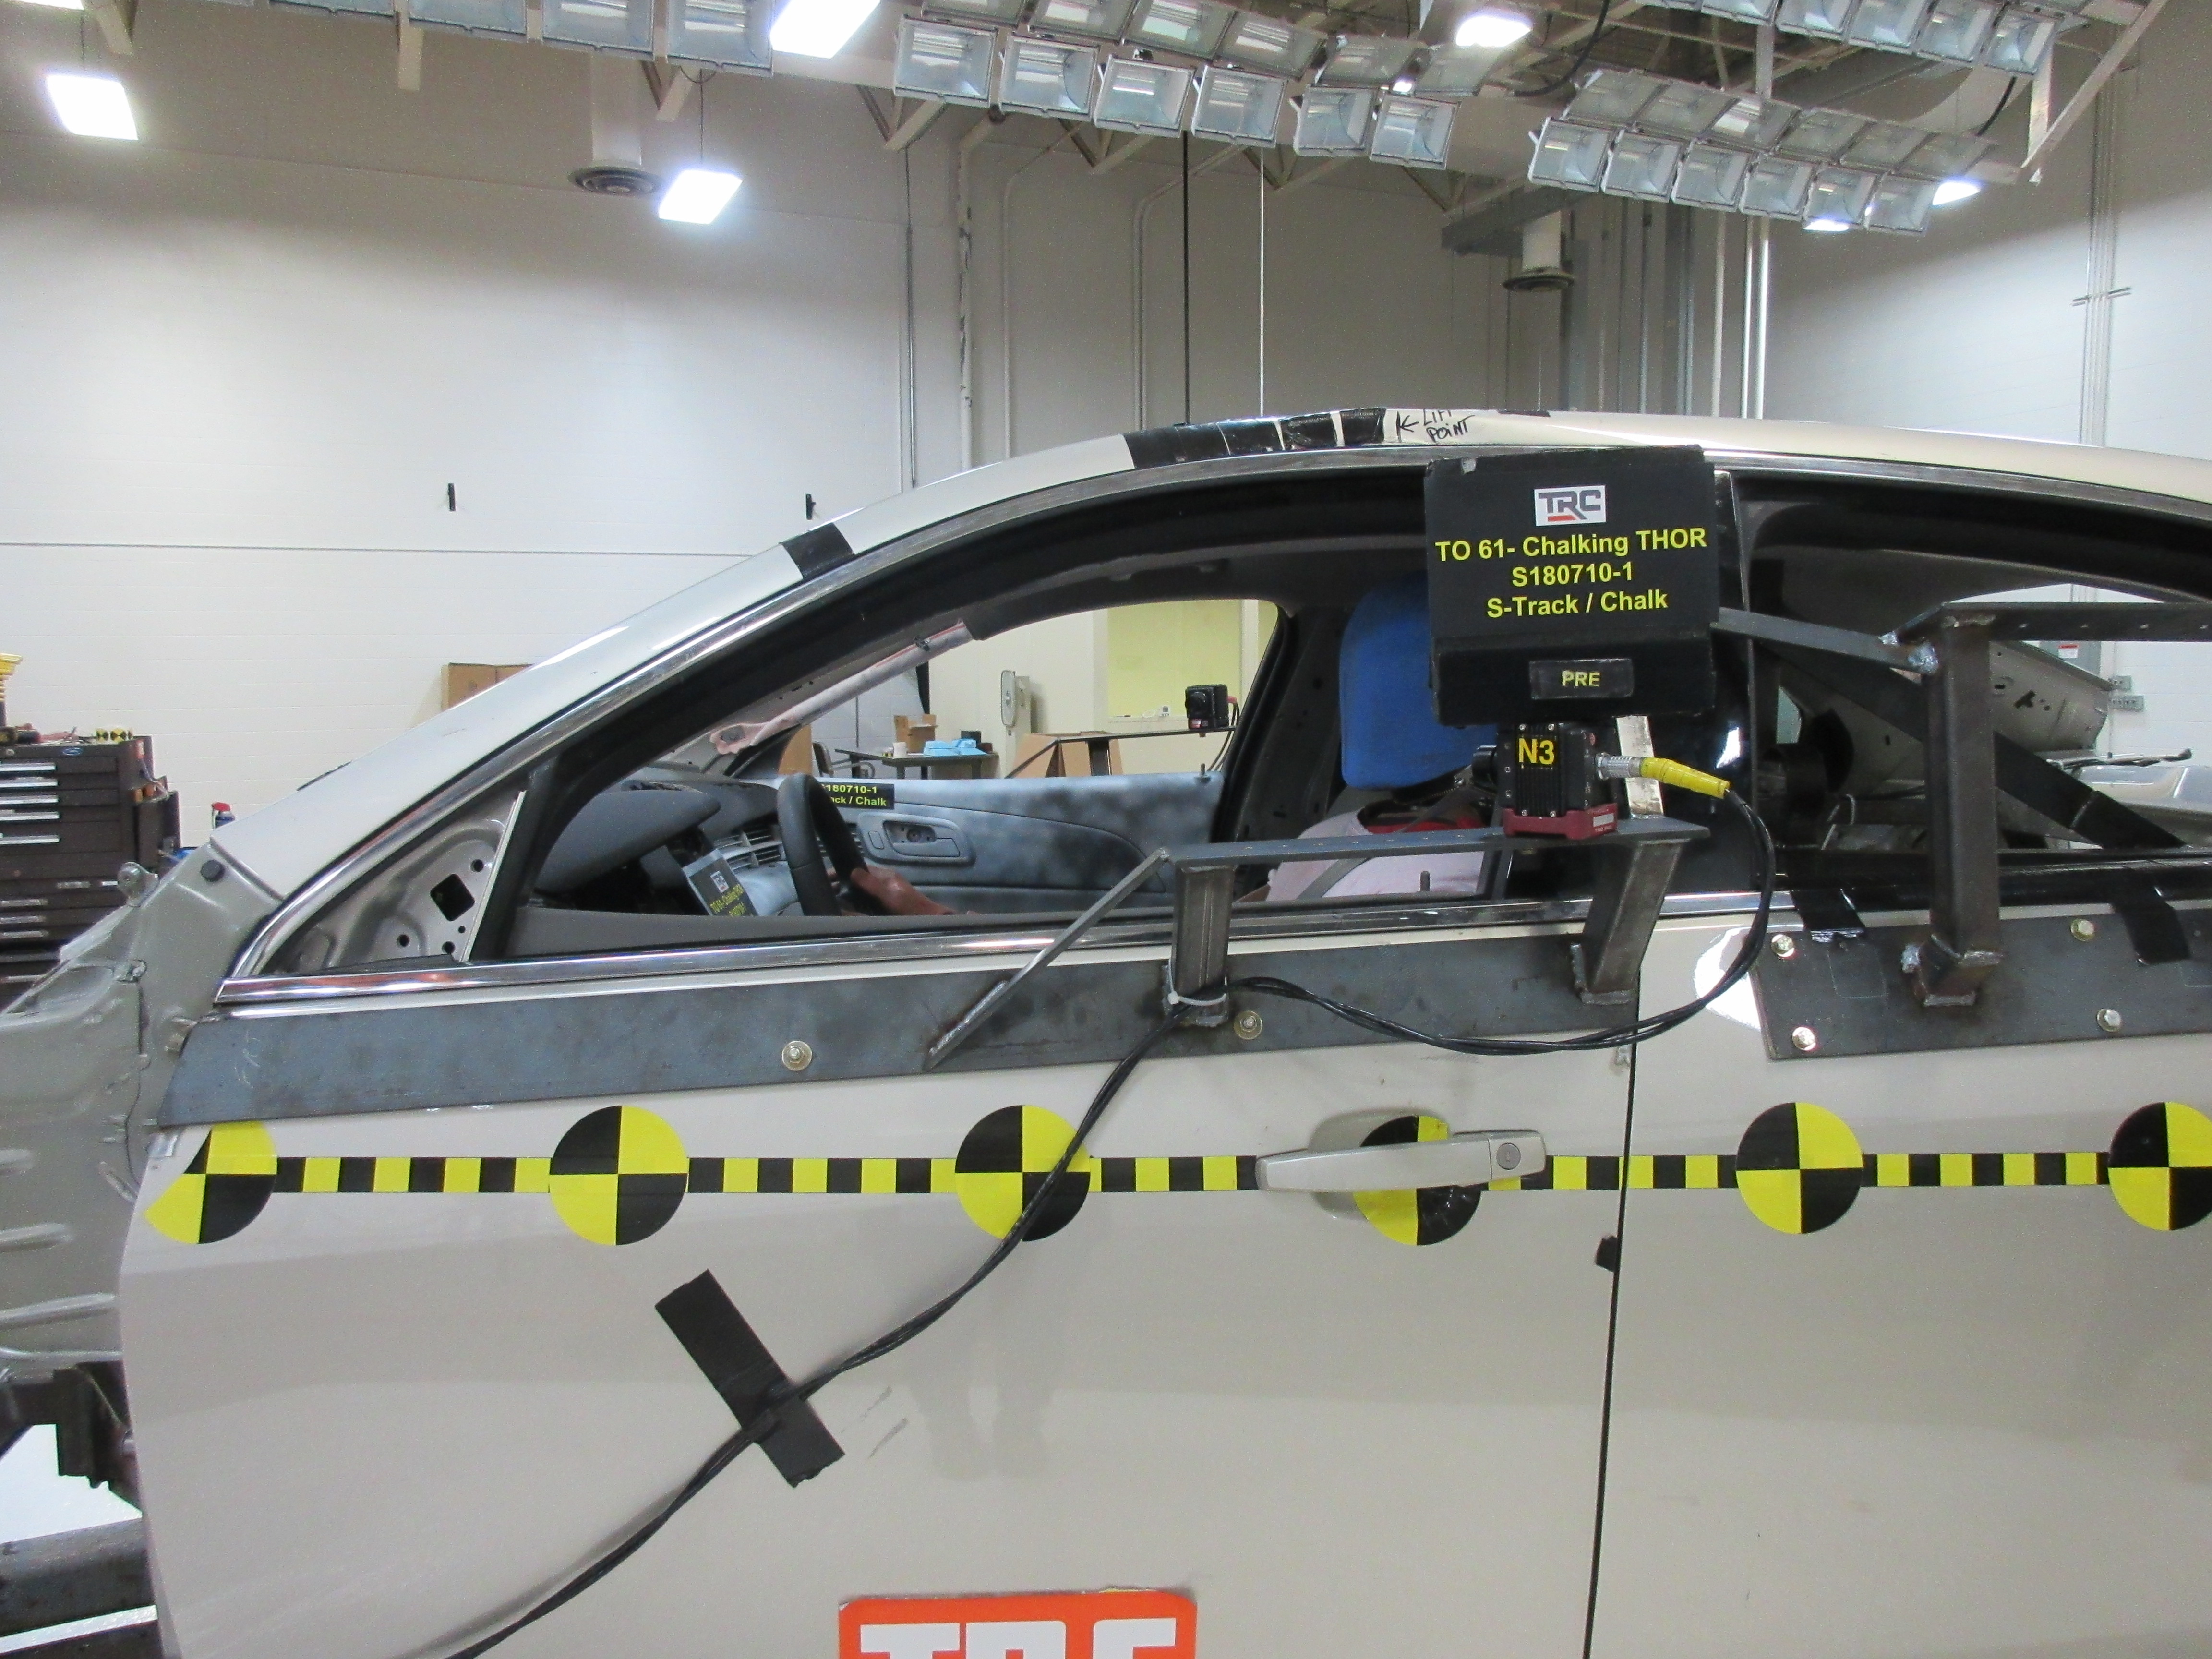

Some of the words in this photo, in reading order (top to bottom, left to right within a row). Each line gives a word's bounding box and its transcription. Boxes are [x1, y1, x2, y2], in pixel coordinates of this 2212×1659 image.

[1538, 490, 1601, 520] TRC
[1435, 540, 1471, 562] TO
[1479, 538, 1515, 559] 61-
[1523, 534, 1629, 557] Chalking
[1636, 528, 1707, 550] THOR
[1512, 562, 1632, 587] S180710-1
[1487, 594, 1579, 618] S-Track
[1586, 593, 1593, 613] /
[1600, 589, 1668, 613] Chalk
[1562, 671, 1601, 688] PRE
[1519, 738, 1555, 765] N3
[848, 796, 853, 804] /
[855, 796, 887, 806] Chalk
